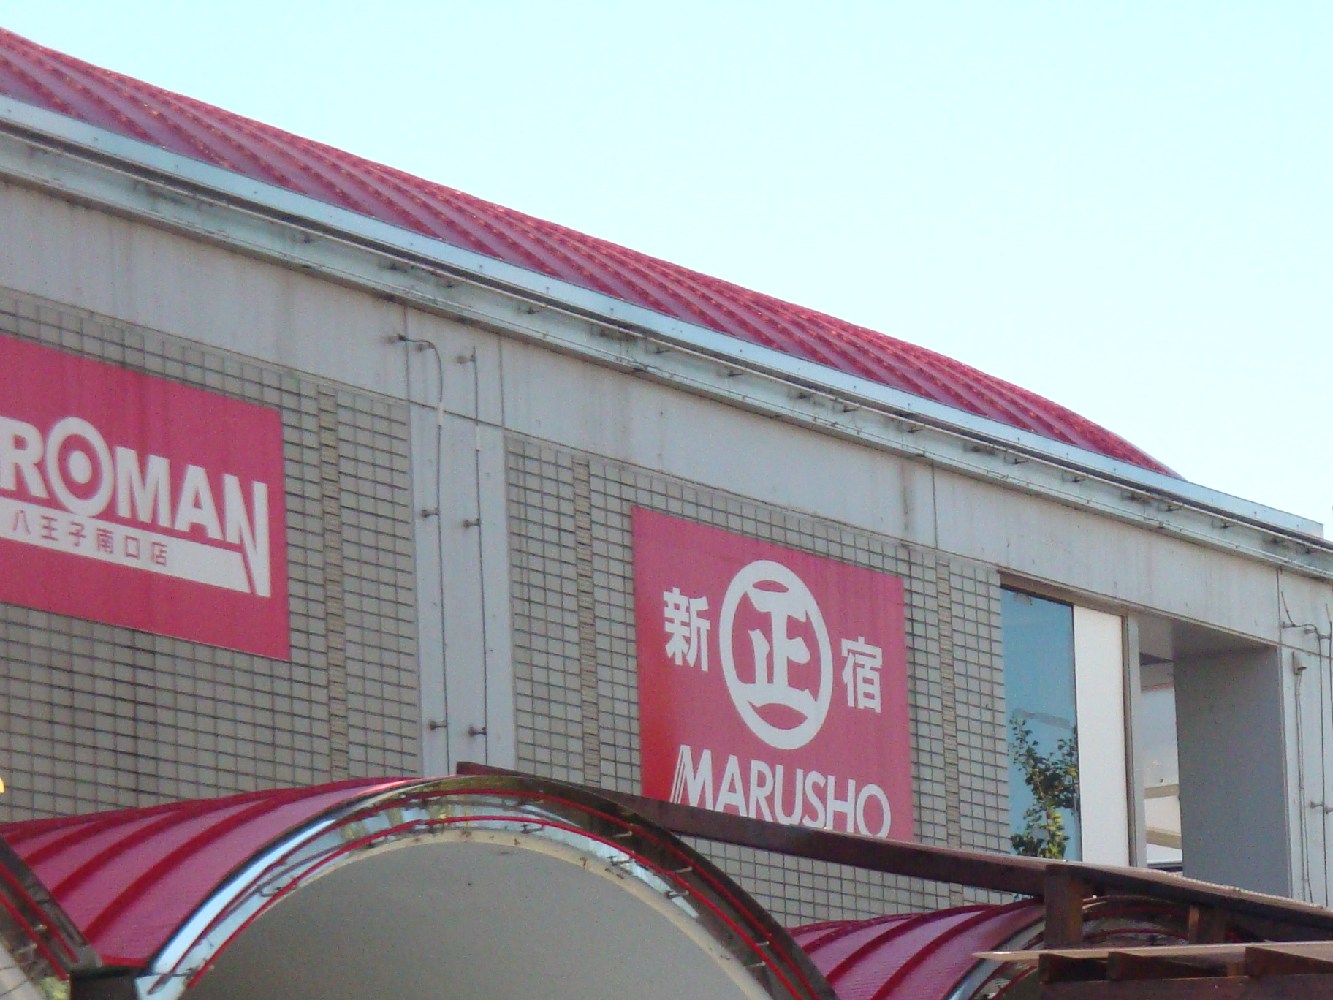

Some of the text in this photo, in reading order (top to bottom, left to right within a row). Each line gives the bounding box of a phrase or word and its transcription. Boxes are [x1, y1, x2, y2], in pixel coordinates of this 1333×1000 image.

[12, 509, 168, 567] 八王子南口店
[669, 744, 892, 839] MARUSHO
